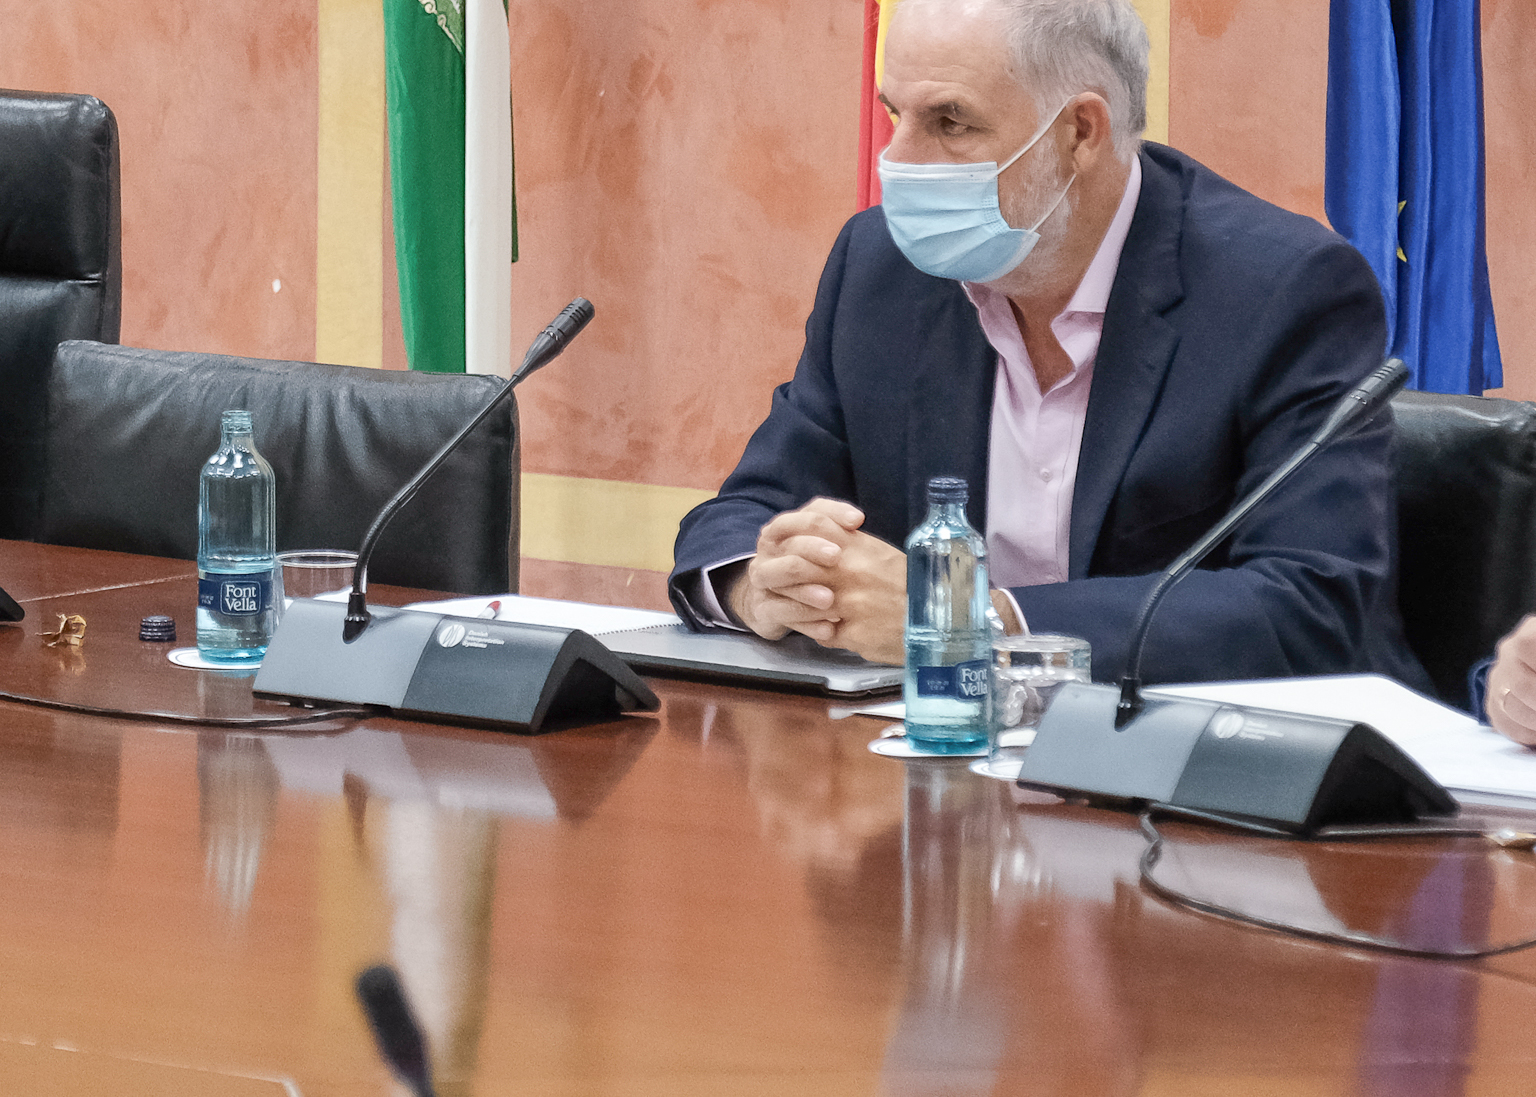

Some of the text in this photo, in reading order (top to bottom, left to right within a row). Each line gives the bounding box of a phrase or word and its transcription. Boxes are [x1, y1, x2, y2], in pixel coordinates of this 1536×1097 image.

[225, 584, 257, 598] Font
[225, 597, 257, 611] Vella
[961, 668, 988, 683] Font
[960, 681, 988, 696] Vella
